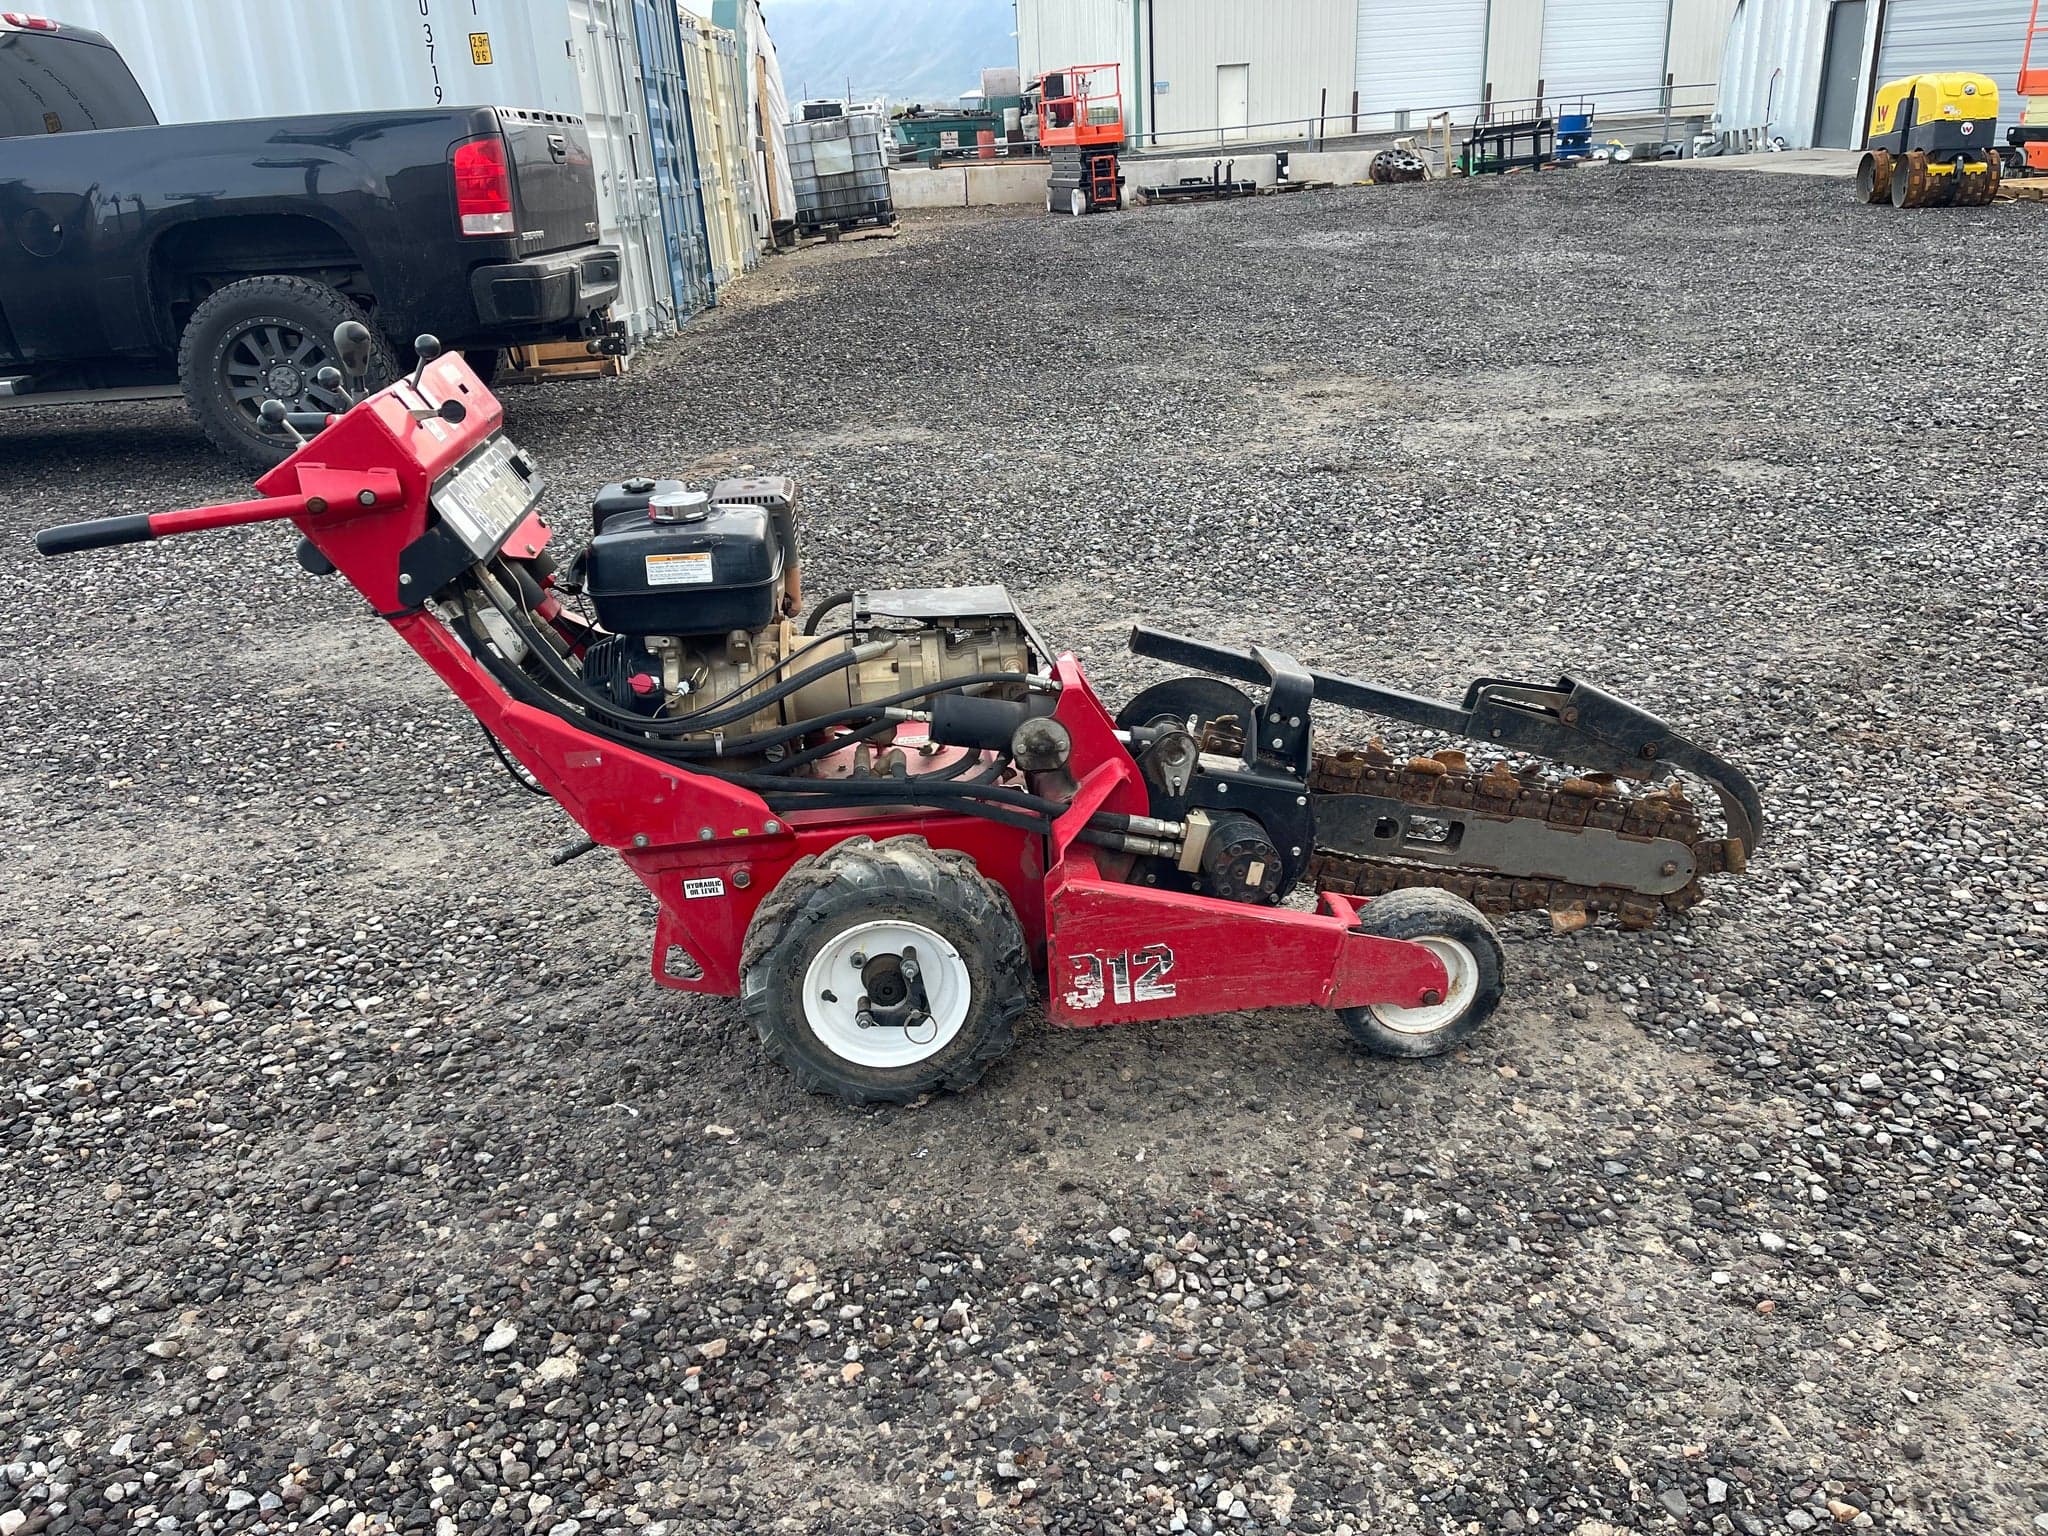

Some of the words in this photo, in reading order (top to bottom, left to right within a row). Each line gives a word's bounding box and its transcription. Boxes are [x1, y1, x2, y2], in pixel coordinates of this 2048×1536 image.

[686, 880, 722, 890] HYDRAULIC
[690, 888, 700, 896] OIL
[701, 887, 719, 895] LEVEL
